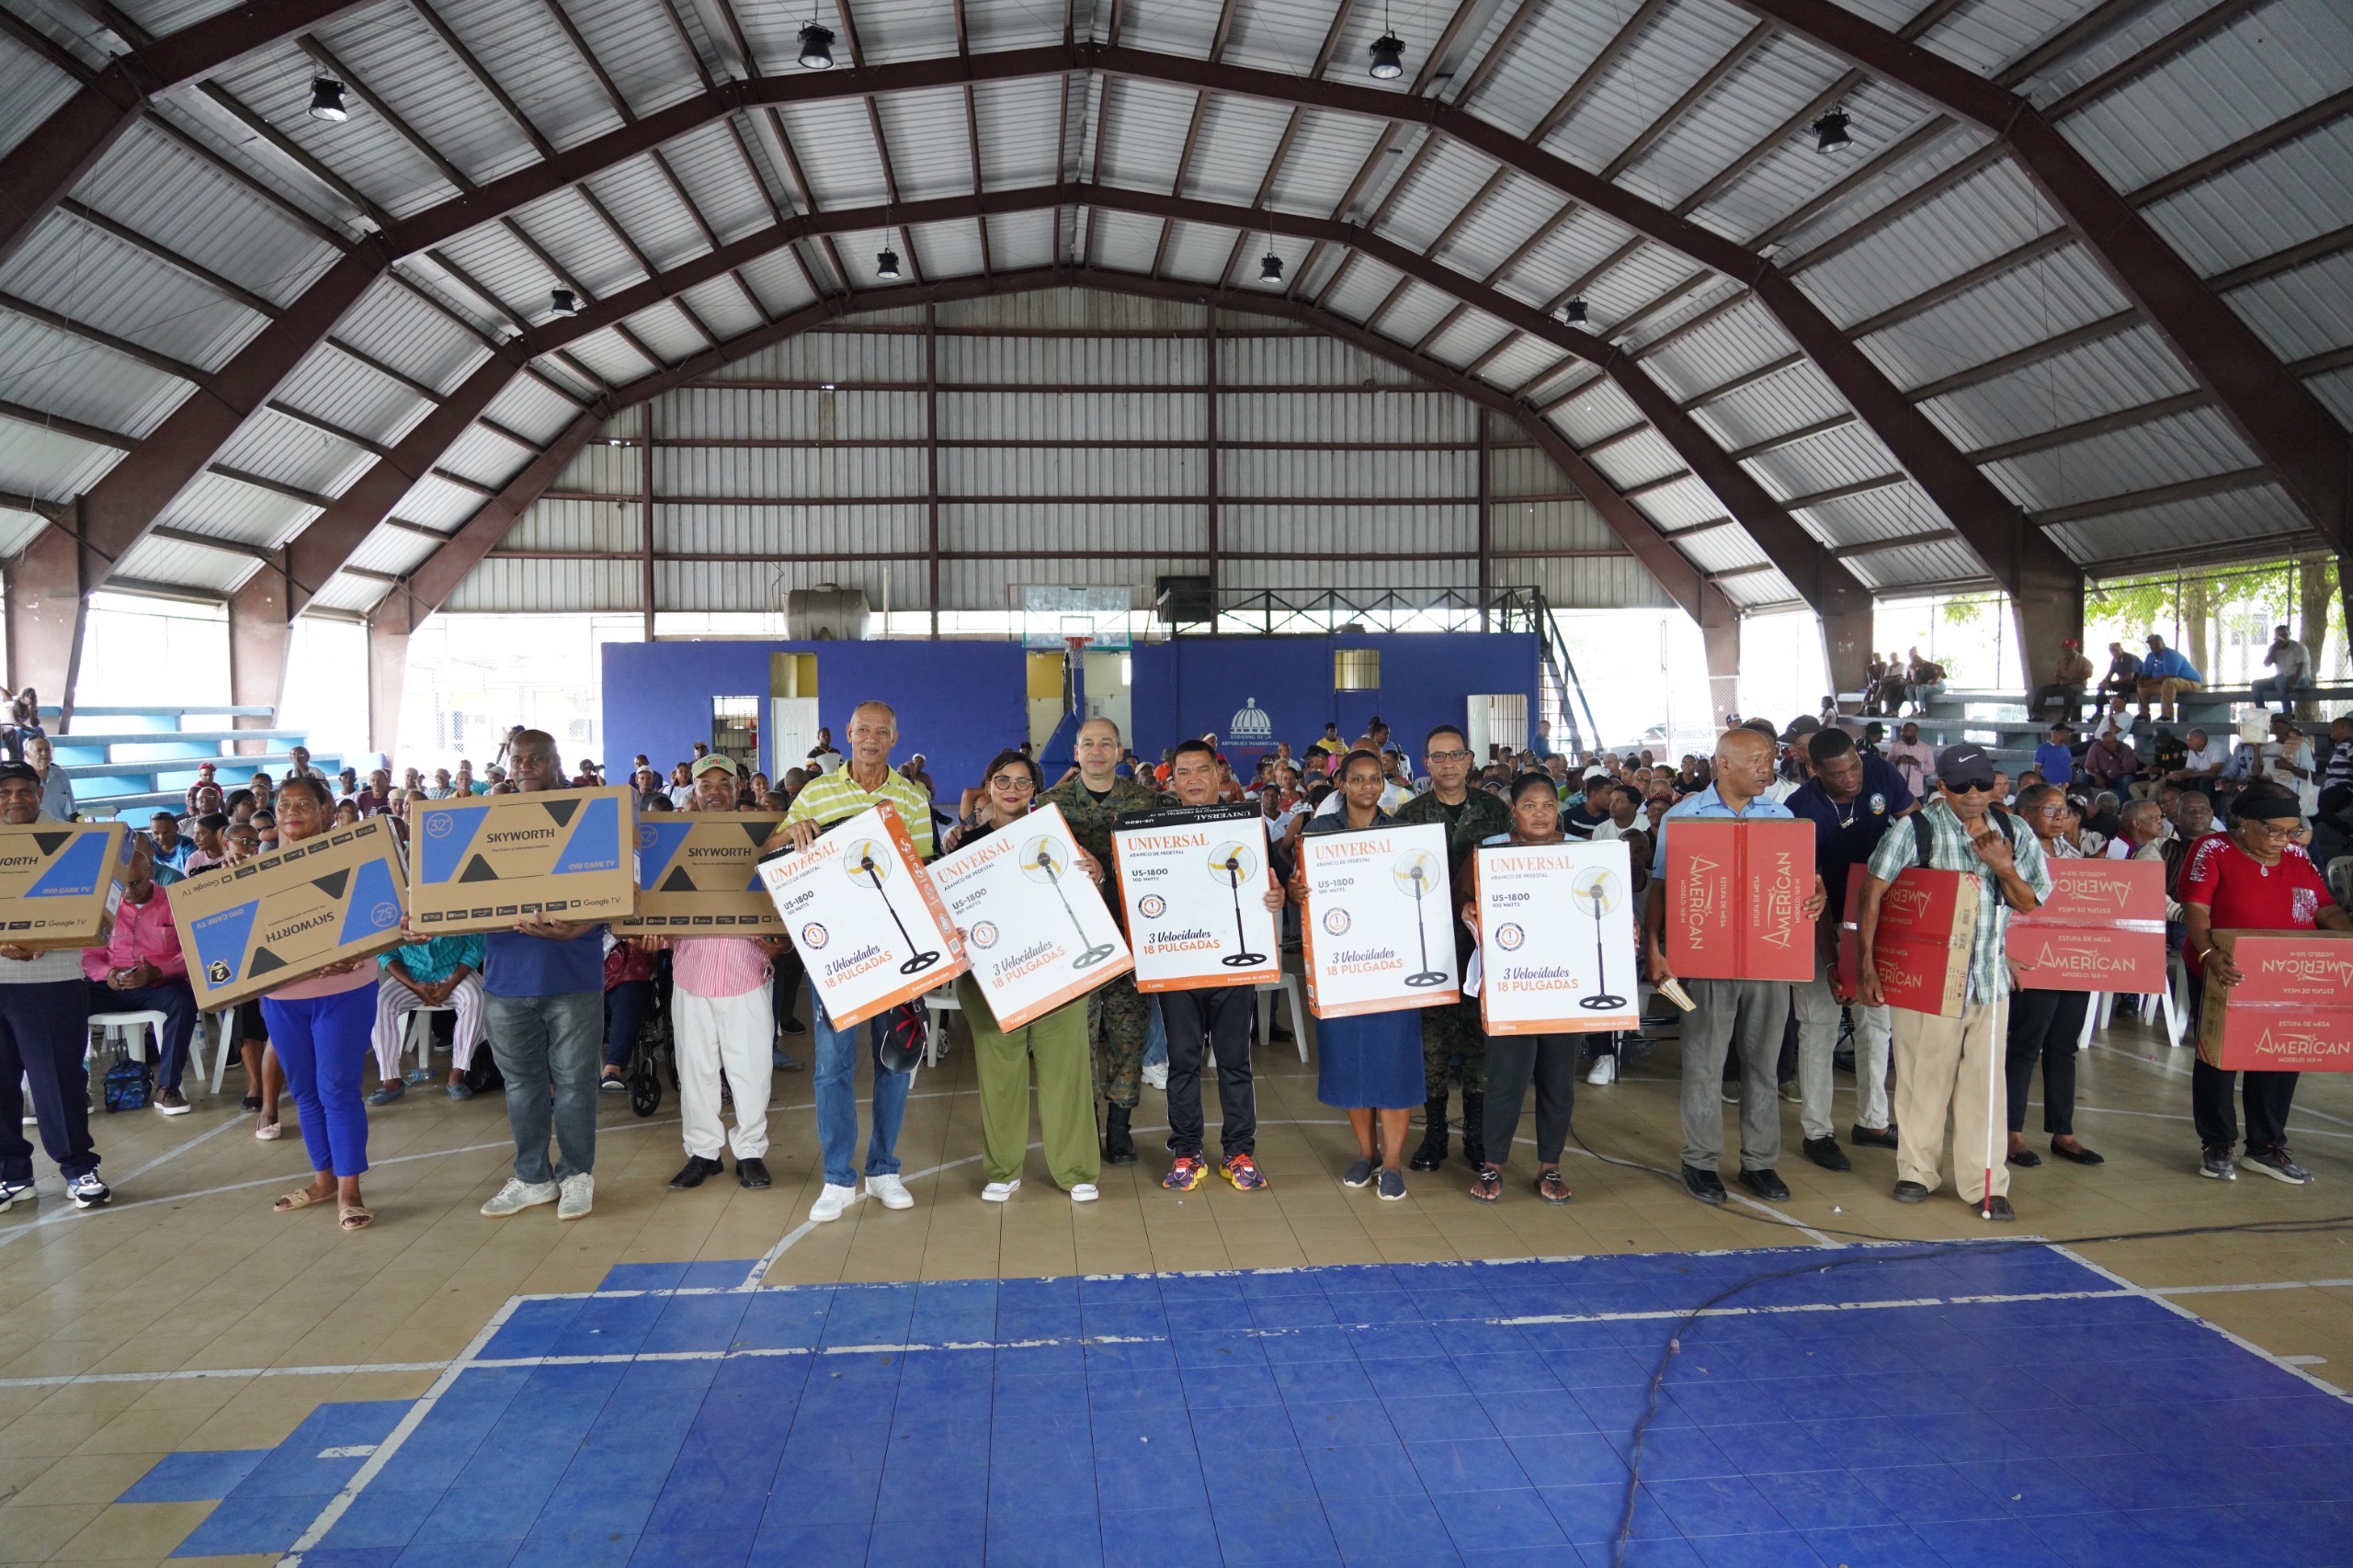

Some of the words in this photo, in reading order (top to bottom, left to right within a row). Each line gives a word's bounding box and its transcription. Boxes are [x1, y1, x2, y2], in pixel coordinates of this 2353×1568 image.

[1193, 811, 1251, 821] UNIVERSAL
[486, 828, 555, 843] SKYWORTH
[1128, 833, 1210, 851] UNIVERSAL
[688, 847, 752, 857] SKYWORTH
[1315, 839, 1395, 860] UNIVERSAL
[584, 860, 604, 869] CARE
[768, 840, 839, 884] UNIVERSAL
[937, 837, 1015, 883] UNIVERSAL
[1490, 855, 1574, 872] UNIVERSAL
[799, 865, 822, 879] PEDESTAL
[972, 863, 995, 877] PEDESTAL
[1131, 868, 1168, 877] US-1800
[193, 880, 220, 892] Google
[1318, 878, 1355, 889] US-1800
[182, 889, 192, 897] TV
[783, 890, 814, 910] US-1800
[952, 888, 987, 910] US-1800
[1492, 892, 1530, 902] US-1800
[1753, 893, 1760, 903] DE
[1760, 852, 1791, 949] AMERICAN
[584, 898, 609, 907] Google
[965, 900, 982, 911] WATTS
[1689, 854, 1721, 949] AMERICAN
[1720, 900, 1727, 909] DE
[1882, 888, 1932, 920] AMERIC
[48, 919, 75, 927] Google
[196, 921, 207, 930] TV
[208, 914, 228, 926] CARE
[266, 912, 335, 943] SKYWORTH
[1148, 933, 1155, 944] 3
[1157, 928, 1212, 943] Velocidades
[1142, 945, 1154, 955] 18
[1158, 939, 1221, 953] PULGADAS
[824, 963, 833, 976] 3
[832, 944, 881, 972] Velocidades
[993, 963, 1001, 976] 3
[1001, 940, 1053, 972] Velocidades
[1332, 952, 1339, 964] 3
[1341, 948, 1395, 963] Velocidades
[2036, 940, 2135, 971] AMERICAN
[824, 977, 836, 989] 18
[836, 950, 893, 984] PULGADAS
[992, 977, 1005, 990] 18
[1005, 946, 1066, 983] PULGADAS
[1326, 966, 1338, 976] 18
[1341, 958, 1404, 974] PULGADAS
[1503, 968, 1510, 980] 3
[1513, 966, 1570, 980] Velocidades
[2262, 960, 2353, 989] AMERICAN
[1497, 982, 1509, 992] 18
[1512, 979, 1579, 992] PULGADAS
[1879, 968, 1923, 989] ERICAN
[2254, 1026, 2350, 1054] AMERICAN
